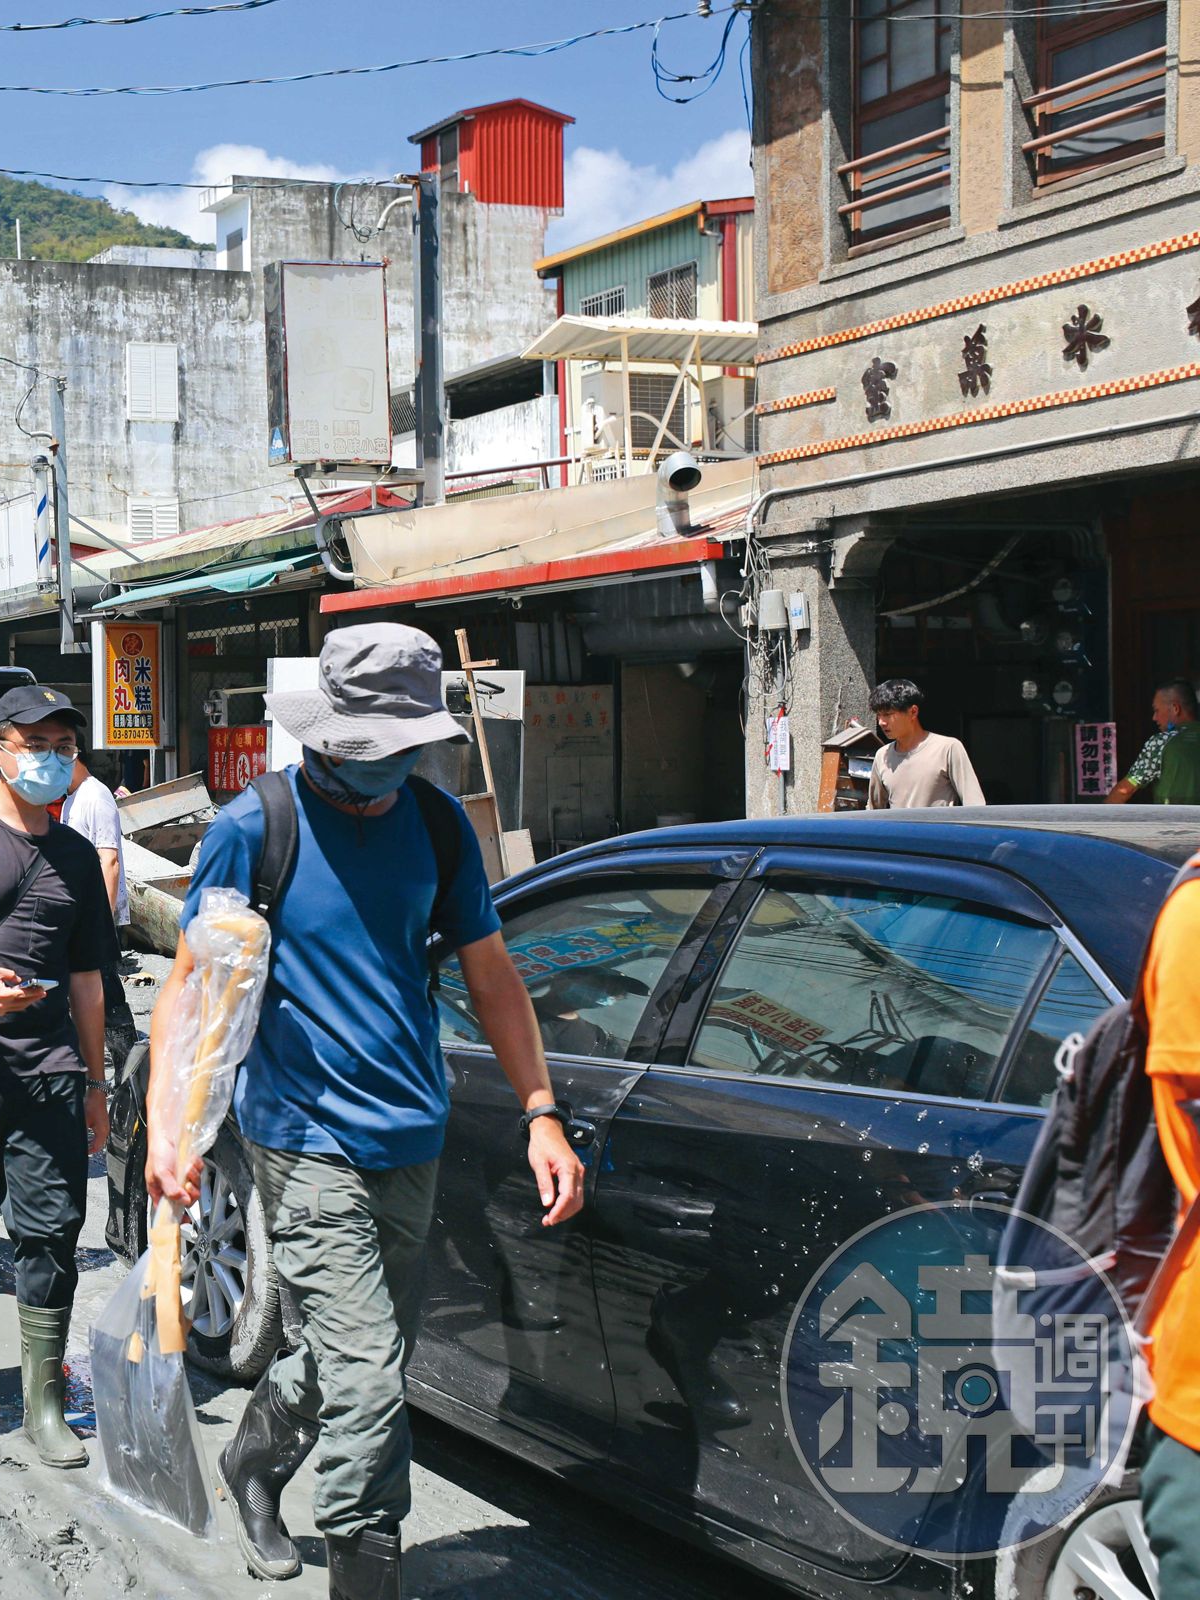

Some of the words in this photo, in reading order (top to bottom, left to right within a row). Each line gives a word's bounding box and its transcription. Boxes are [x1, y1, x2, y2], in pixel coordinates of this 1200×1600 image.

[114, 657, 132, 711] 肉丸
[134, 657, 152, 711] 米糕
[1080, 726, 1100, 793] 請勿停車
